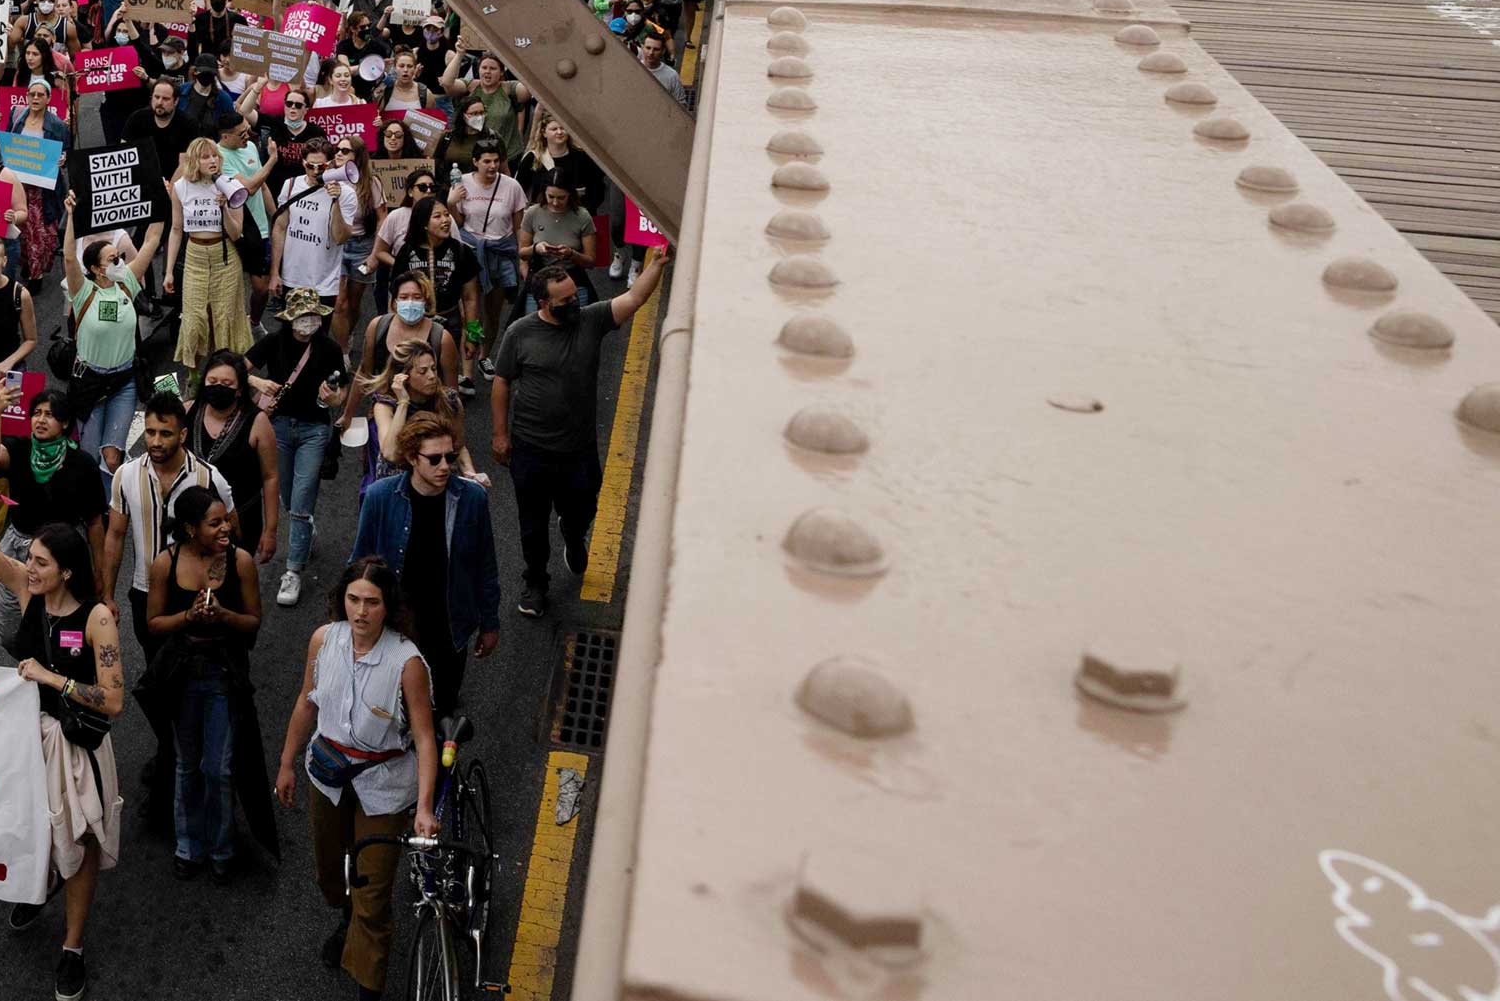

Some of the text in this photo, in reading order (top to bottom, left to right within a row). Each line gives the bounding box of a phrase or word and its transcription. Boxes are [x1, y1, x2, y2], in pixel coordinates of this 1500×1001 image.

[289, 10, 311, 21] BANS
[284, 19, 327, 37] OFF OUR
[283, 29, 320, 43] BODIES
[84, 56, 109, 68] BANS
[309, 114, 342, 125] BANS
[335, 123, 365, 133] OUR
[91, 150, 137, 169] STAND
[93, 170, 130, 188] WITH
[93, 187, 139, 207] BLACK
[194, 198, 211, 206] RAPE
[295, 199, 320, 212] 1973
[93, 203, 150, 224] WOMEN
[193, 209, 208, 217] NOT
[299, 215, 310, 226] to
[288, 227, 323, 247] infinity
